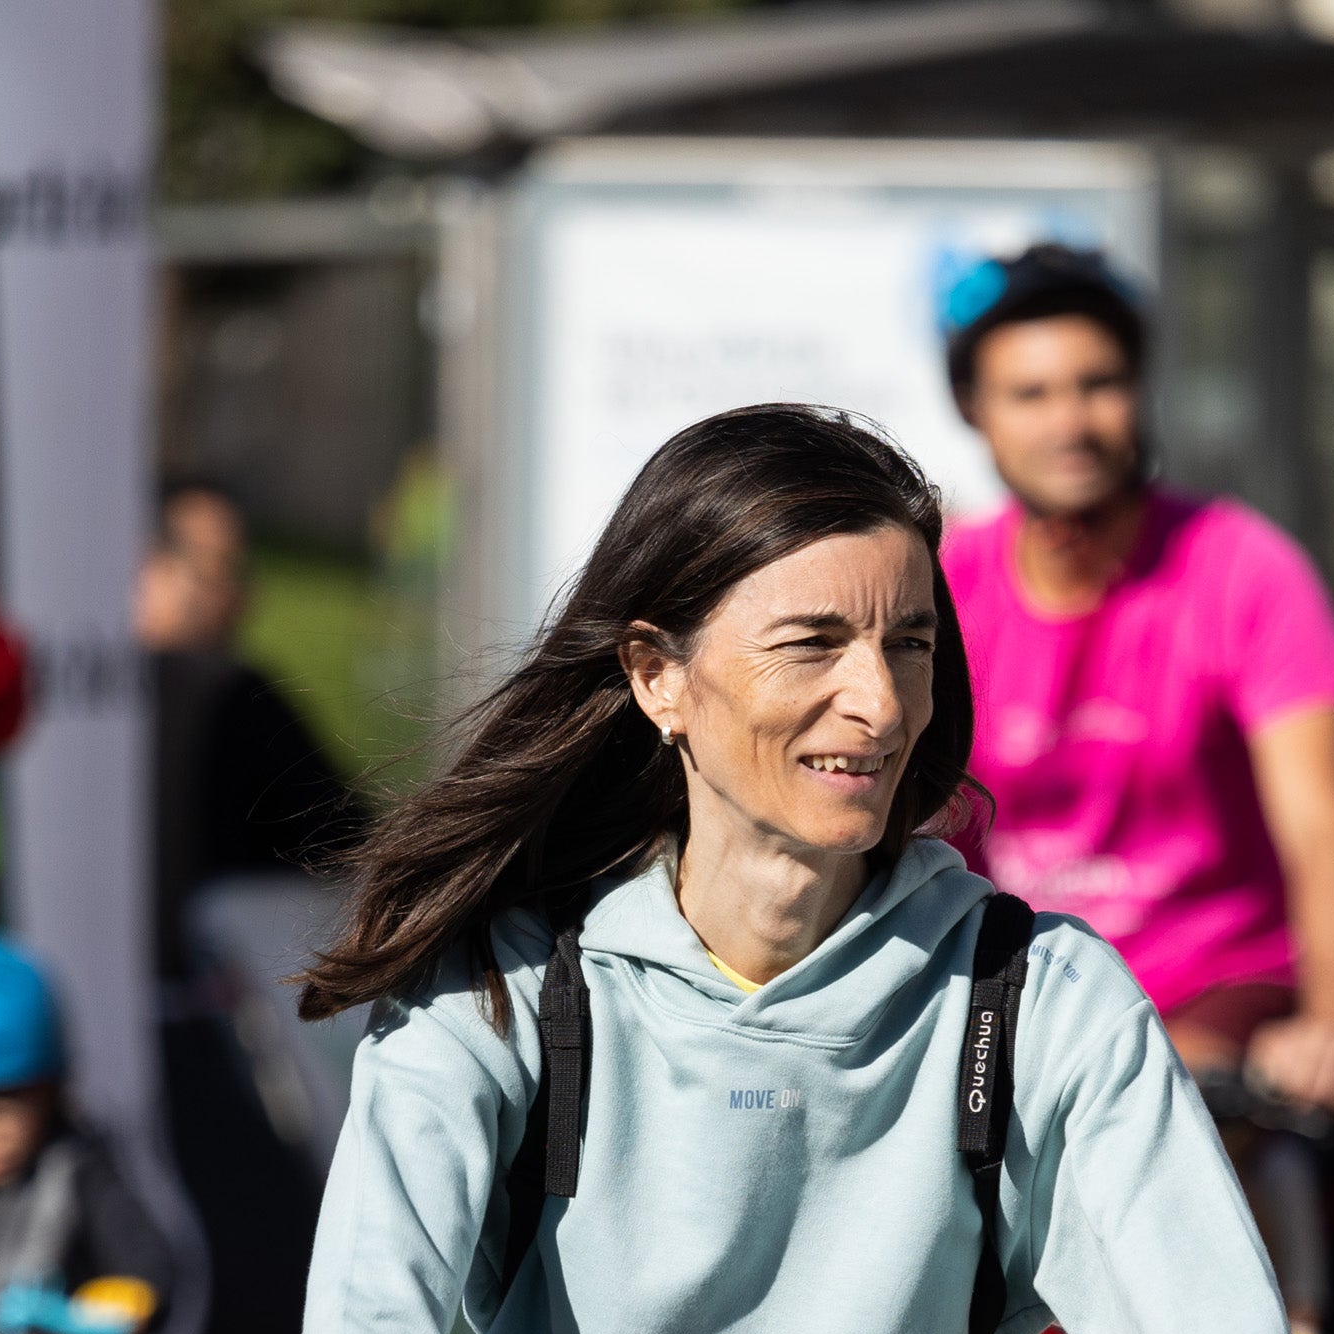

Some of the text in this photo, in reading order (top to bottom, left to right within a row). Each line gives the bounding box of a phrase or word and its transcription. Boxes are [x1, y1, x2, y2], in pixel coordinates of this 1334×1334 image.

[1063, 960, 1083, 984] YOU
[968, 1010, 994, 1114] Quechua
[729, 1088, 801, 1110] MOVE ON
